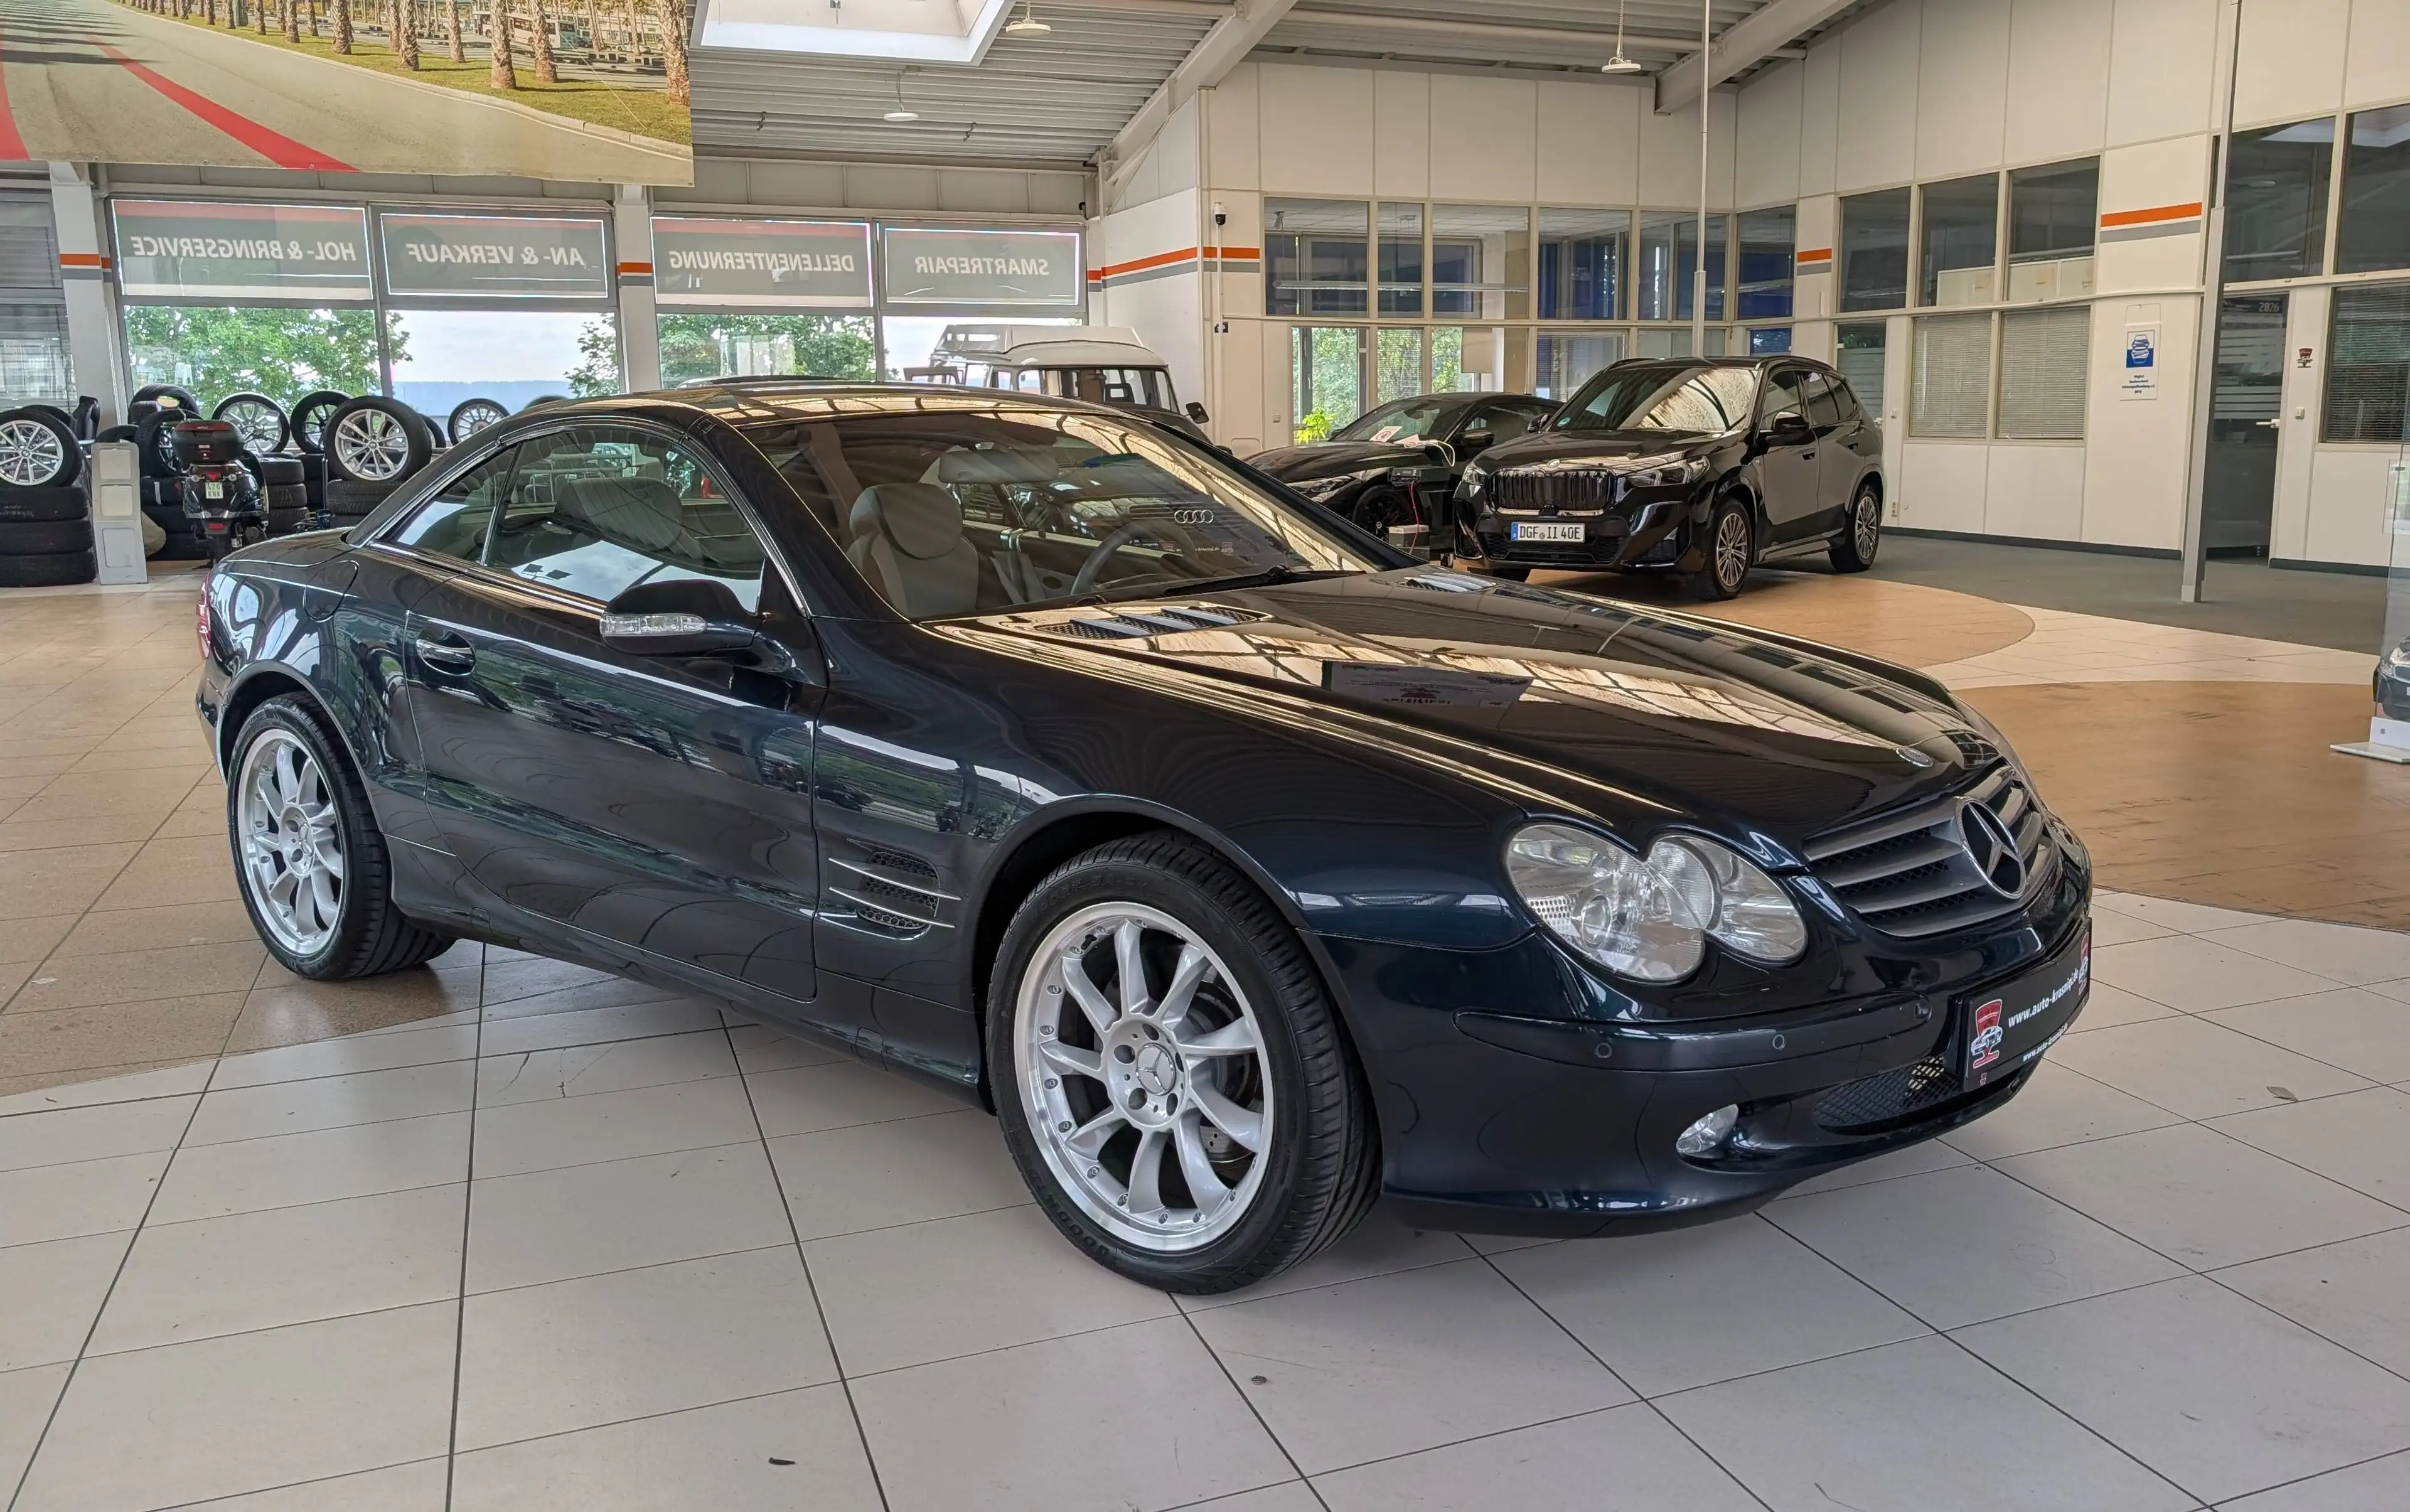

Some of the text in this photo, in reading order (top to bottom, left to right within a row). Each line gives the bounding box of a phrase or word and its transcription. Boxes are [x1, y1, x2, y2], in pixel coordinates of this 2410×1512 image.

[1519, 526, 1581, 540] DGF II 40E
